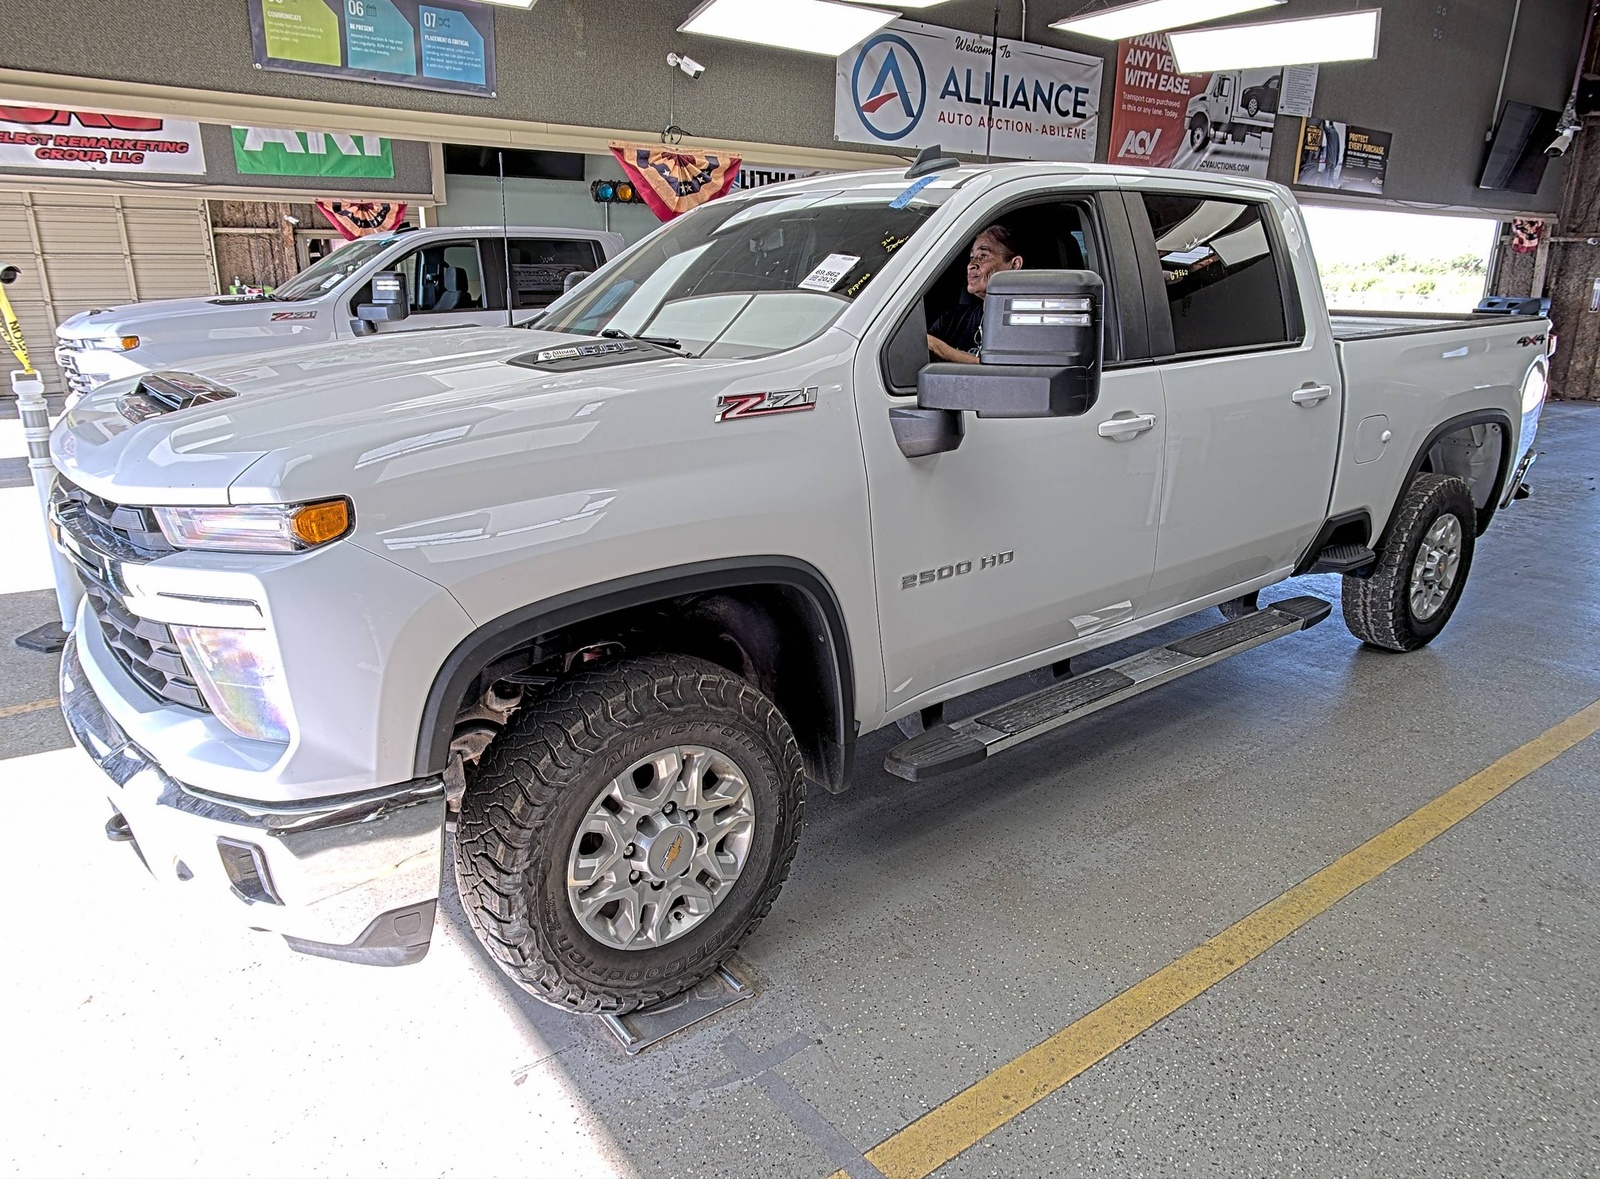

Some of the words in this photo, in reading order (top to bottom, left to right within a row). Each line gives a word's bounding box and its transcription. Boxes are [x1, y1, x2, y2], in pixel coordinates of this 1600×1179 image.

[348, 0, 364, 17] 06
[355, 24, 375, 33] PRESENT
[423, 12, 437, 28] 07
[424, 34, 447, 44] PLACEMENT
[452, 38, 470, 47] CRITICAL
[999, 44, 1012, 58] To
[1124, 48, 1155, 68] ANY
[1124, 67, 1159, 89] WITH
[1158, 76, 1191, 95] EASE.
[939, 66, 1089, 119] ALLIANCE
[1123, 92, 1145, 103] Transport
[1145, 97, 1156, 105] cars
[1156, 99, 1181, 109] purchased
[1121, 102, 1126, 110] in
[1127, 104, 1136, 112] this
[1143, 107, 1151, 116] any
[1152, 108, 1163, 116] lane.
[1164, 109, 1179, 120] Today.
[938, 111, 973, 126] AUTO
[978, 116, 1032, 134] AUCTION
[1041, 124, 1086, 140] ABILENE
[54, 135, 189, 154] REMARKETING
[1117, 128, 1162, 158] ACV
[1348, 133, 1369, 144] PROTECT
[1348, 141, 1363, 151] EVERY
[35, 147, 107, 165] GROUP,
[111, 152, 145, 165] LLC
[1200, 160, 1250, 173] CVAUCTIONS.COM
[818, 275, 837, 284] 2025
[270, 311, 318, 322] Z71
[714, 385, 818, 423] Z71
[900, 560, 972, 591] 2500
[980, 549, 1014, 570] HD
[603, 721, 760, 777] All-Terrain
[556, 929, 723, 982] BFGoodrich
